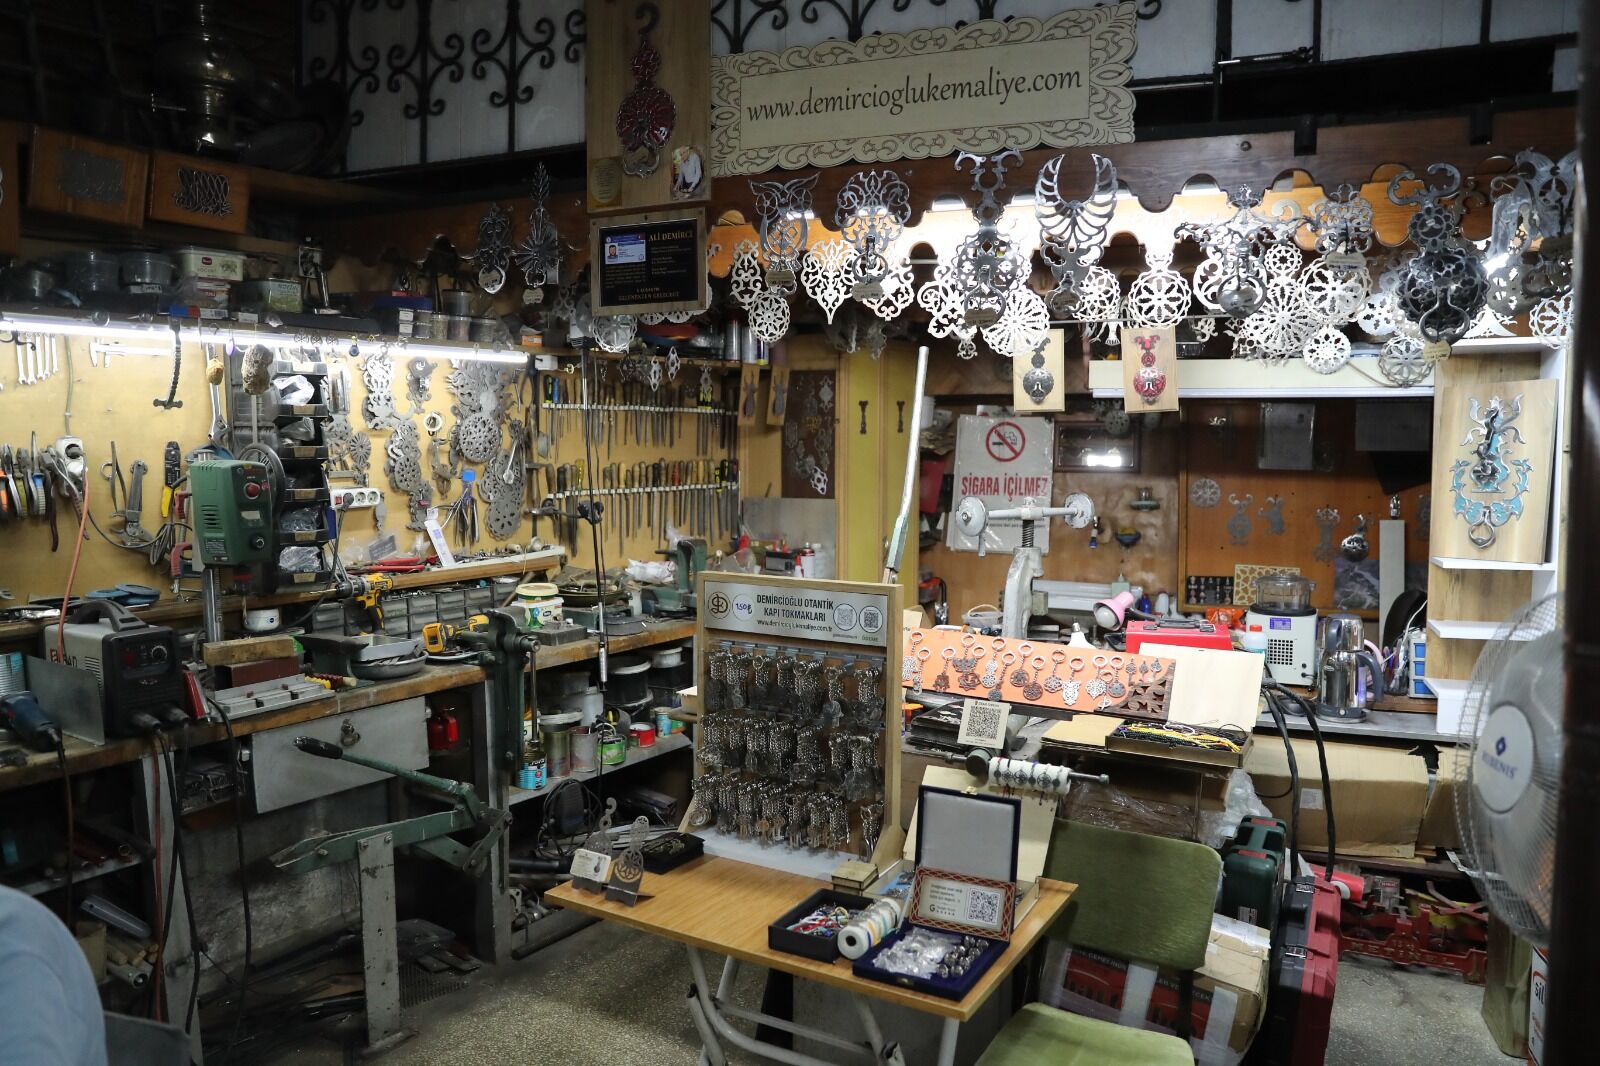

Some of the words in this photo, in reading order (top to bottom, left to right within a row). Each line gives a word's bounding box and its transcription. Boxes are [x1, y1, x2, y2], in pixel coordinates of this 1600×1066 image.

[747, 66, 1082, 121] www.demircioglukemaliye.com
[961, 472, 999, 496] SİGARA
[1003, 472, 1048, 502] İÇİLMEZ
[756, 594, 803, 607] DEMİRCİOĞLU
[804, 596, 834, 609] OTANTİK
[763, 607, 780, 618] KAPI
[782, 609, 826, 622] TOKMAKLARI
